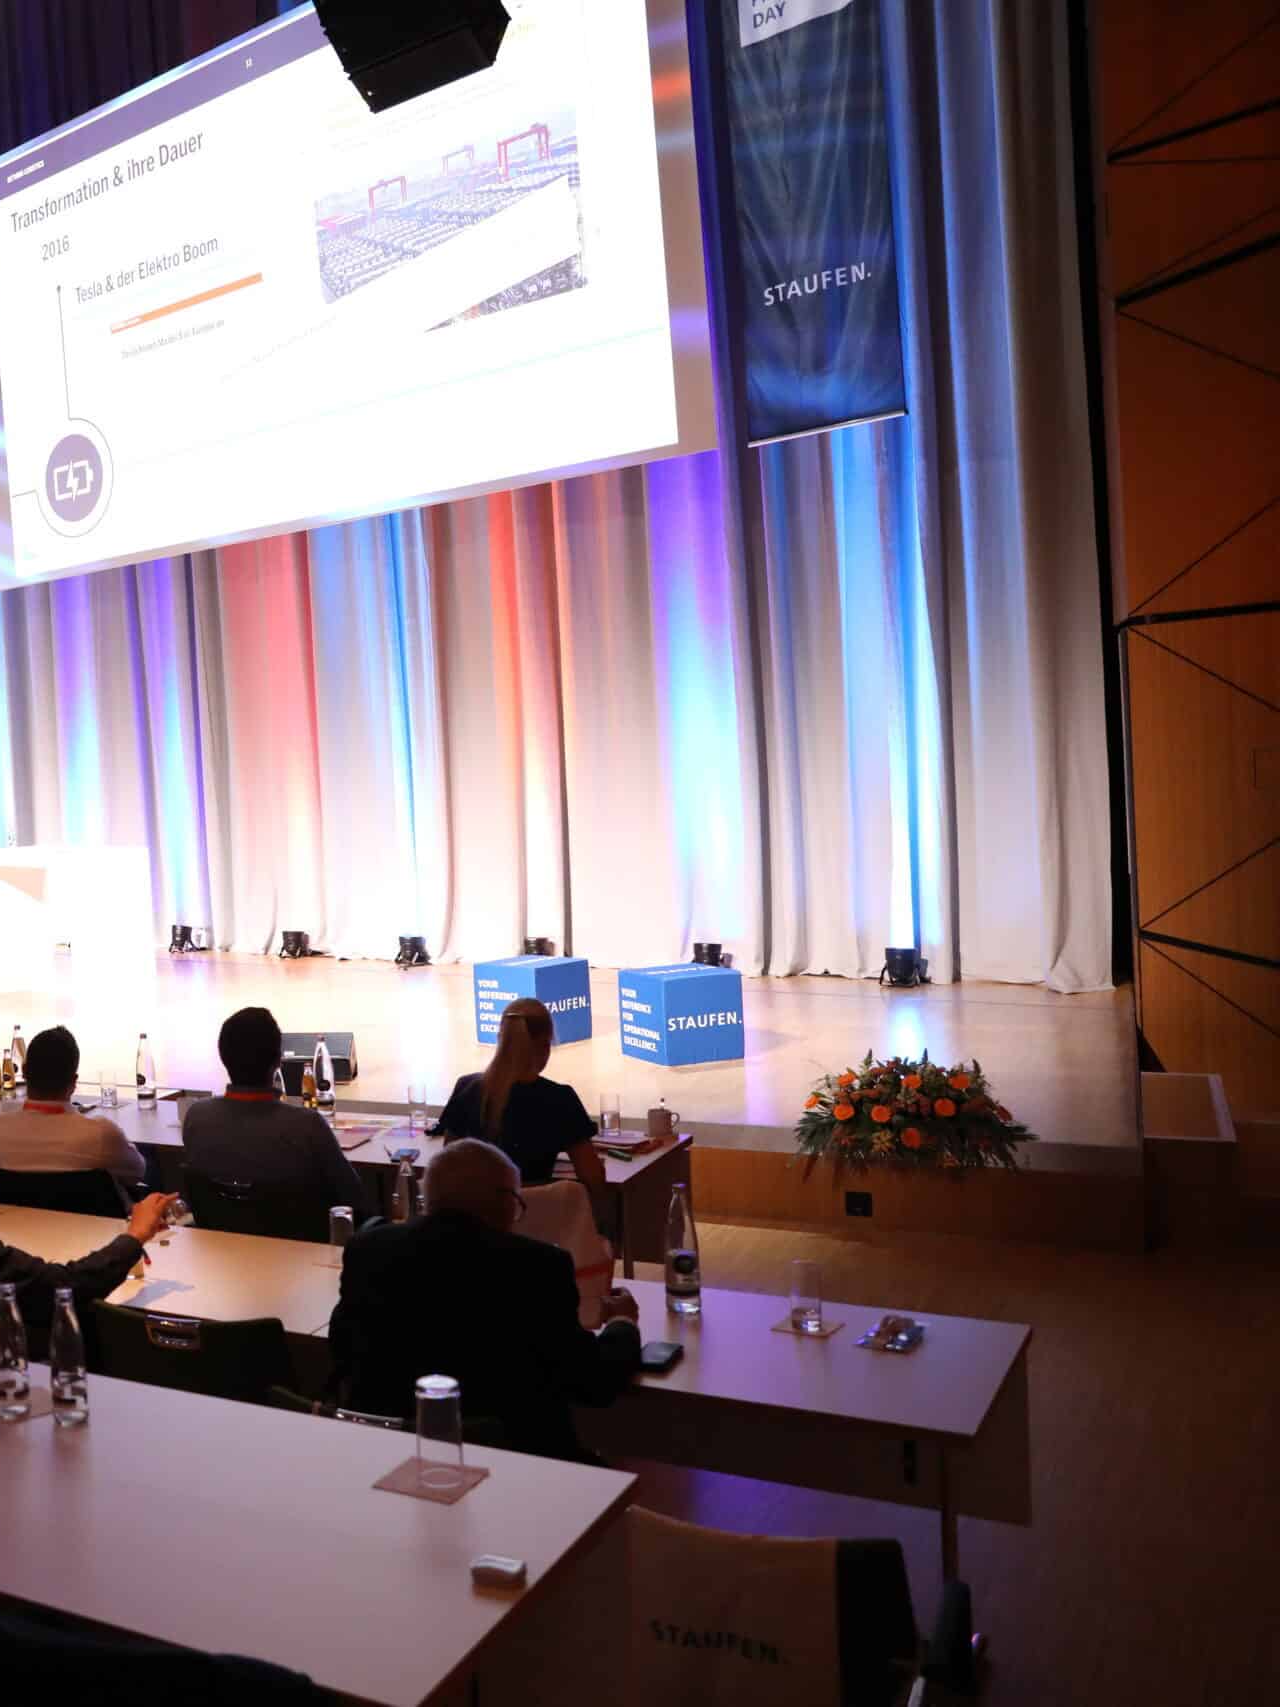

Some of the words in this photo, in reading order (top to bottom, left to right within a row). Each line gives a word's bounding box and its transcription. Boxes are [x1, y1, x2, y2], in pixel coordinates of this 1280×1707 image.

[752, 1, 786, 29] DAY
[10, 179, 109, 233] Transformation
[112, 165, 124, 187] &
[127, 155, 155, 182] ihre
[158, 132, 204, 167] Dauer
[41, 235, 71, 261] 2016
[74, 279, 103, 304] Tesla
[105, 274, 116, 294] &
[117, 268, 136, 289] der
[138, 252, 181, 281] Elektro
[183, 237, 219, 264] Boom
[762, 260, 873, 307] STAUFEN.
[478, 979, 499, 989] YOUR
[479, 1001, 495, 1010] FOR
[543, 994, 590, 1014] TAUFEN.
[666, 1011, 743, 1032] STAUFEN.
[649, 1617, 791, 1665] STAUFEN.
